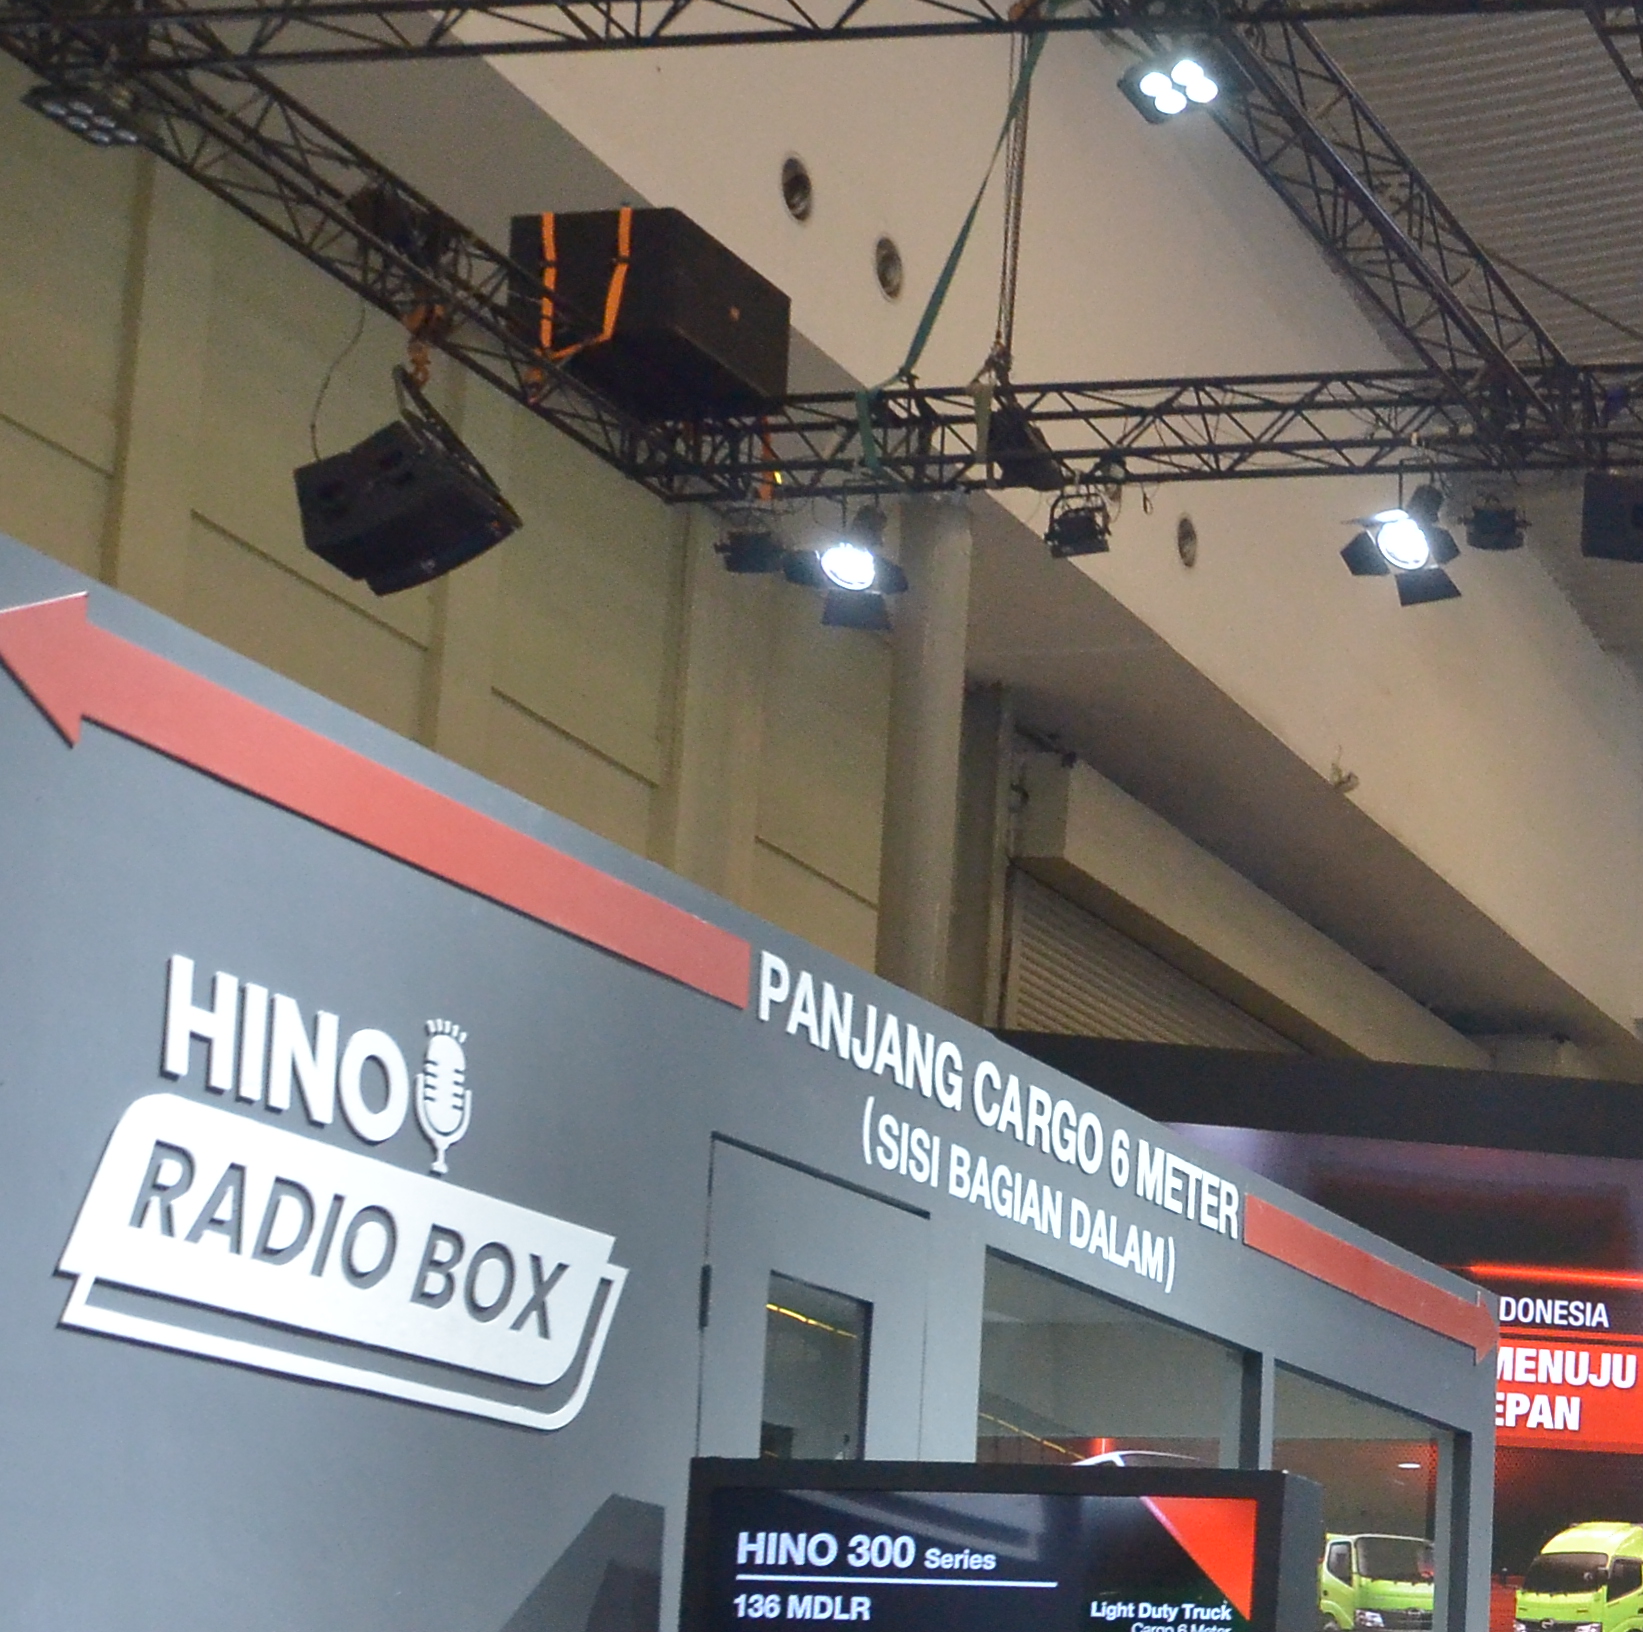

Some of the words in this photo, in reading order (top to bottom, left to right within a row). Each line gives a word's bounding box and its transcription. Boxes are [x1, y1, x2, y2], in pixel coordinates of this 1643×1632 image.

[160, 953, 408, 1145] HINO
[757, 950, 963, 1111] PANJANG
[972, 1060, 1104, 1175] CARGO
[1110, 1128, 1130, 1188] 6
[1136, 1138, 1240, 1240] METER
[129, 1137, 397, 1291] RADIO
[409, 1223, 571, 1342] BOX
[862, 1096, 940, 1188] (SISI
[948, 1148, 1063, 1240] BAGIAN
[1069, 1197, 1176, 1293] DALAM)
[733, 1594, 781, 1620] 136
[787, 1595, 871, 1622] MDLR
[736, 1531, 838, 1569] HINO
[847, 1534, 916, 1568] 300
[924, 1547, 997, 1571] Series
[1090, 1601, 1134, 1622] Light
[1138, 1601, 1179, 1624] Duty
[1182, 1601, 1232, 1622] Truck
